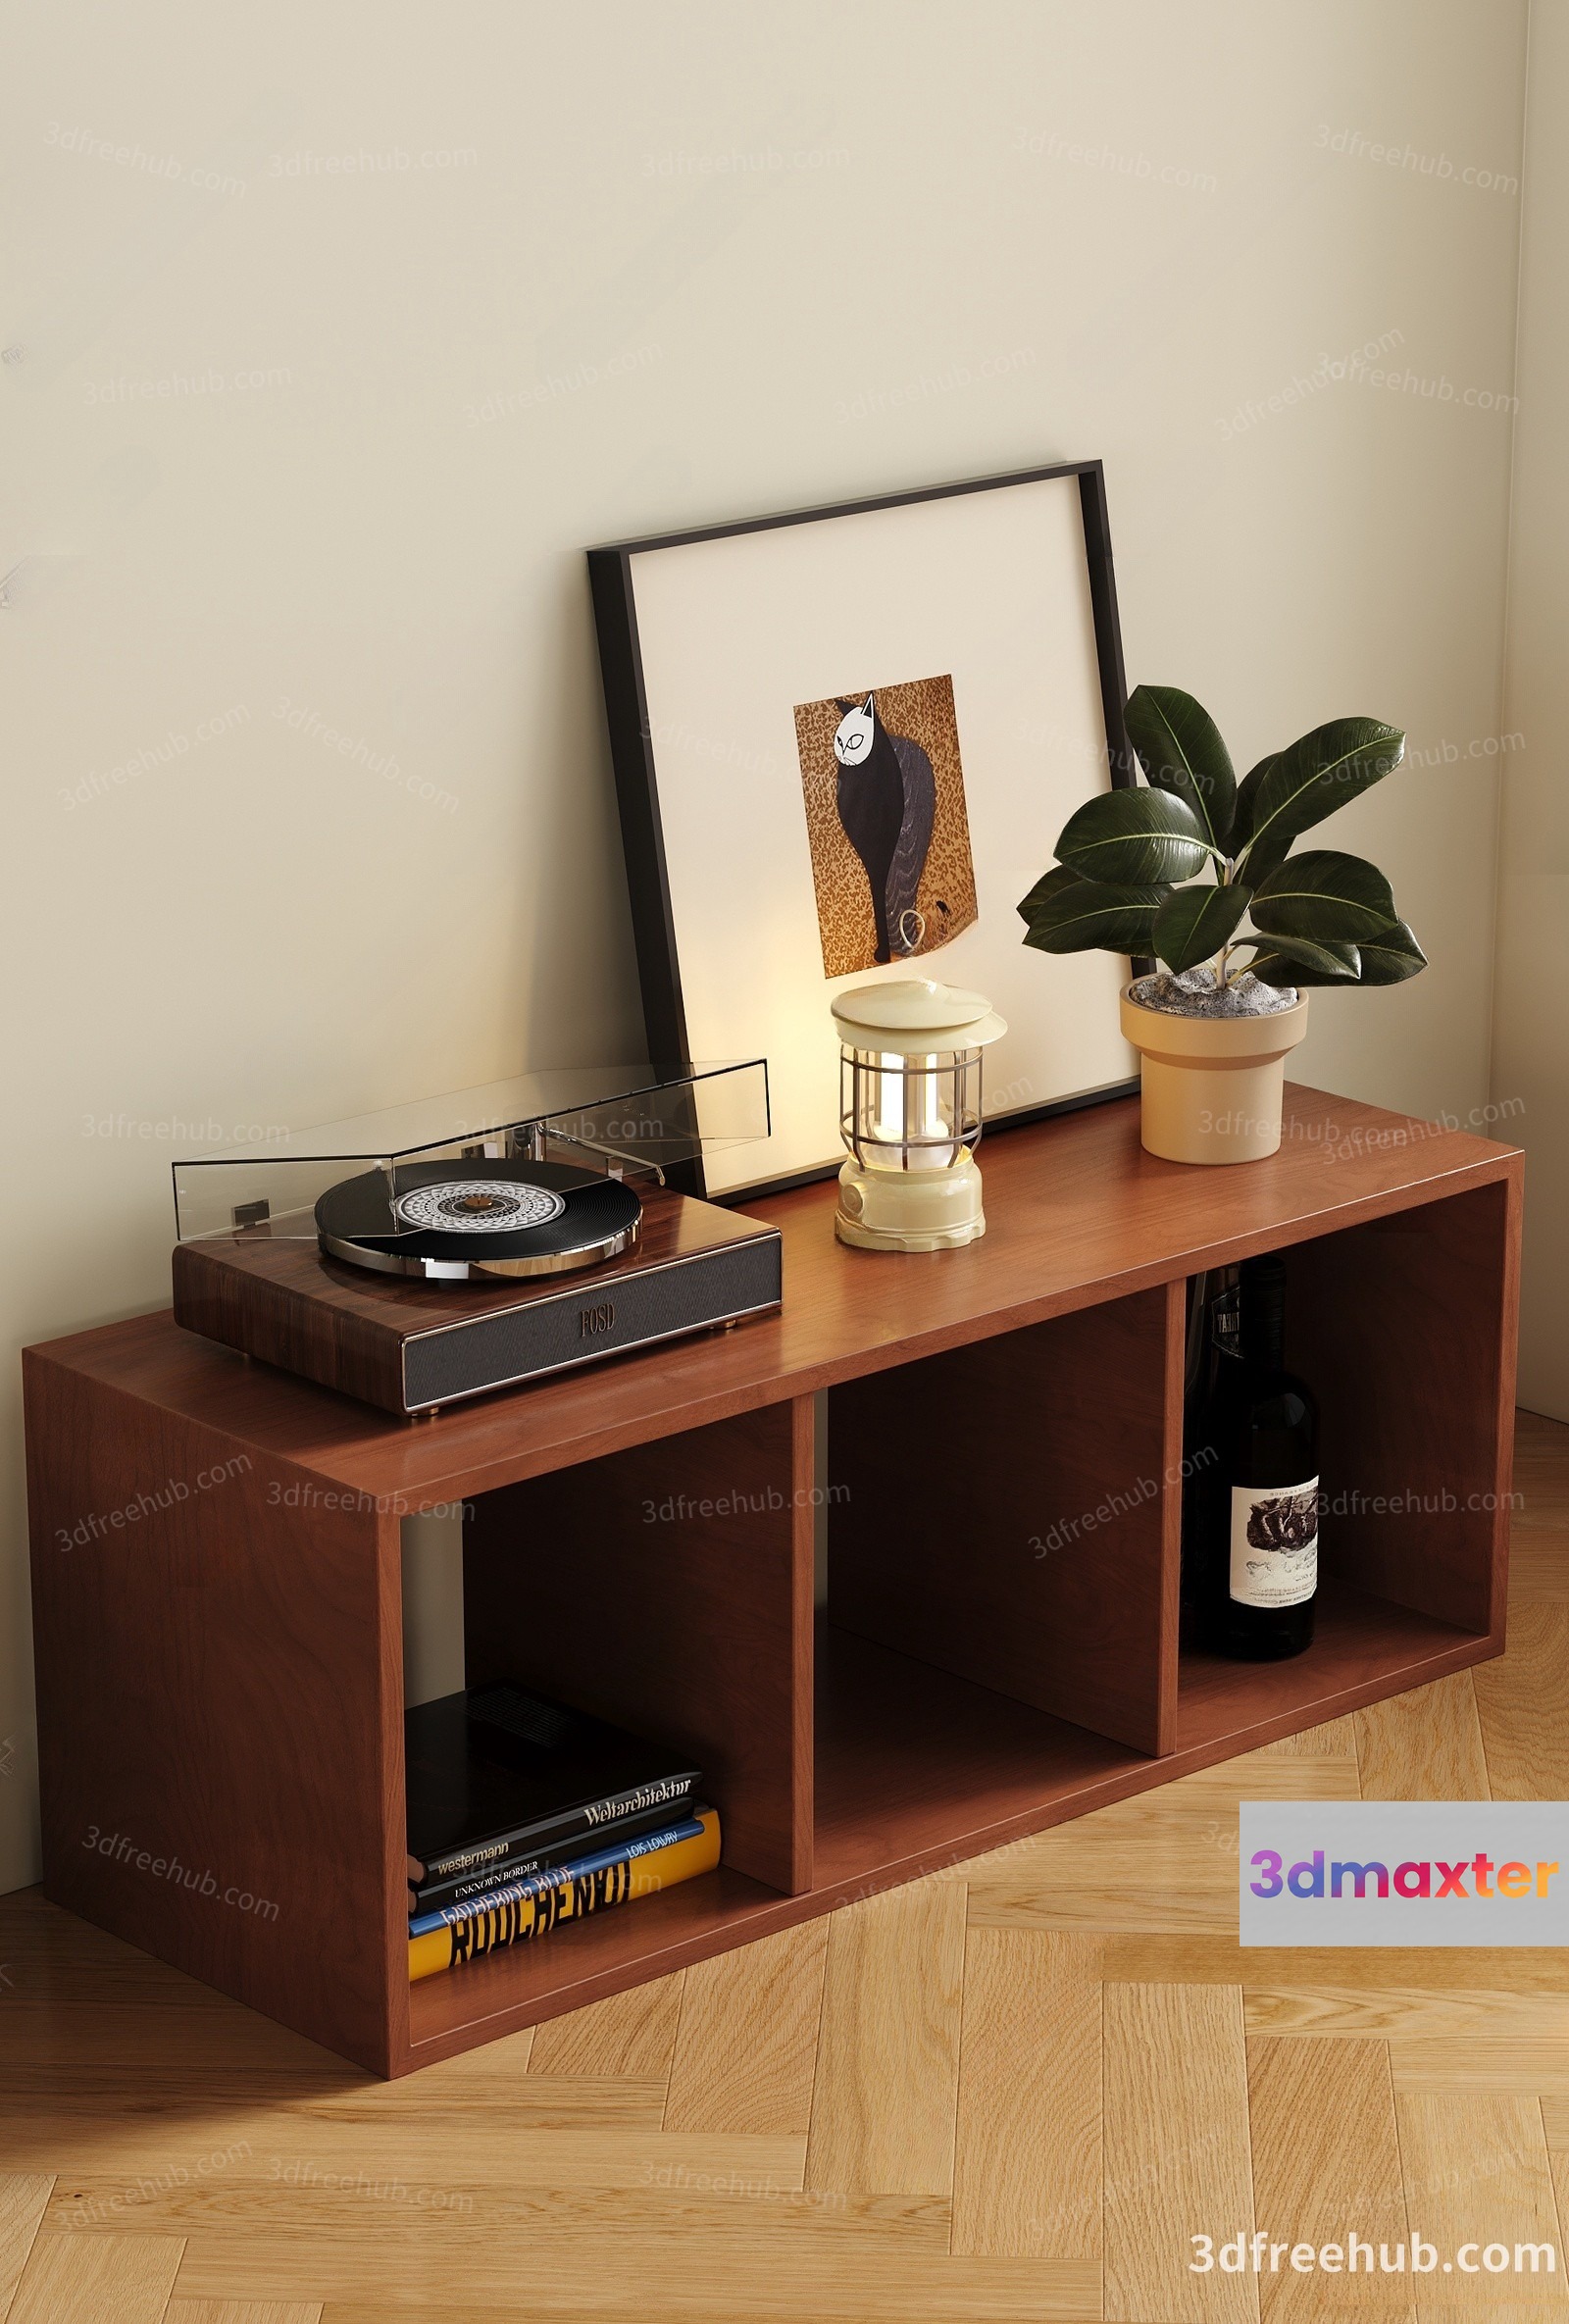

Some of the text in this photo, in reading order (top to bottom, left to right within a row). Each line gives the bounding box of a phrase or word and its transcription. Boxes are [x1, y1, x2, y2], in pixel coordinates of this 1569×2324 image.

[582, 1302, 615, 1337] FOSD
[583, 1778, 691, 1826] Weltarchitektur
[437, 1842, 509, 1875] westermann
[625, 1831, 678, 1859] LOIS LOWRY
[454, 1860, 538, 1898] UNKNOWN BORDER
